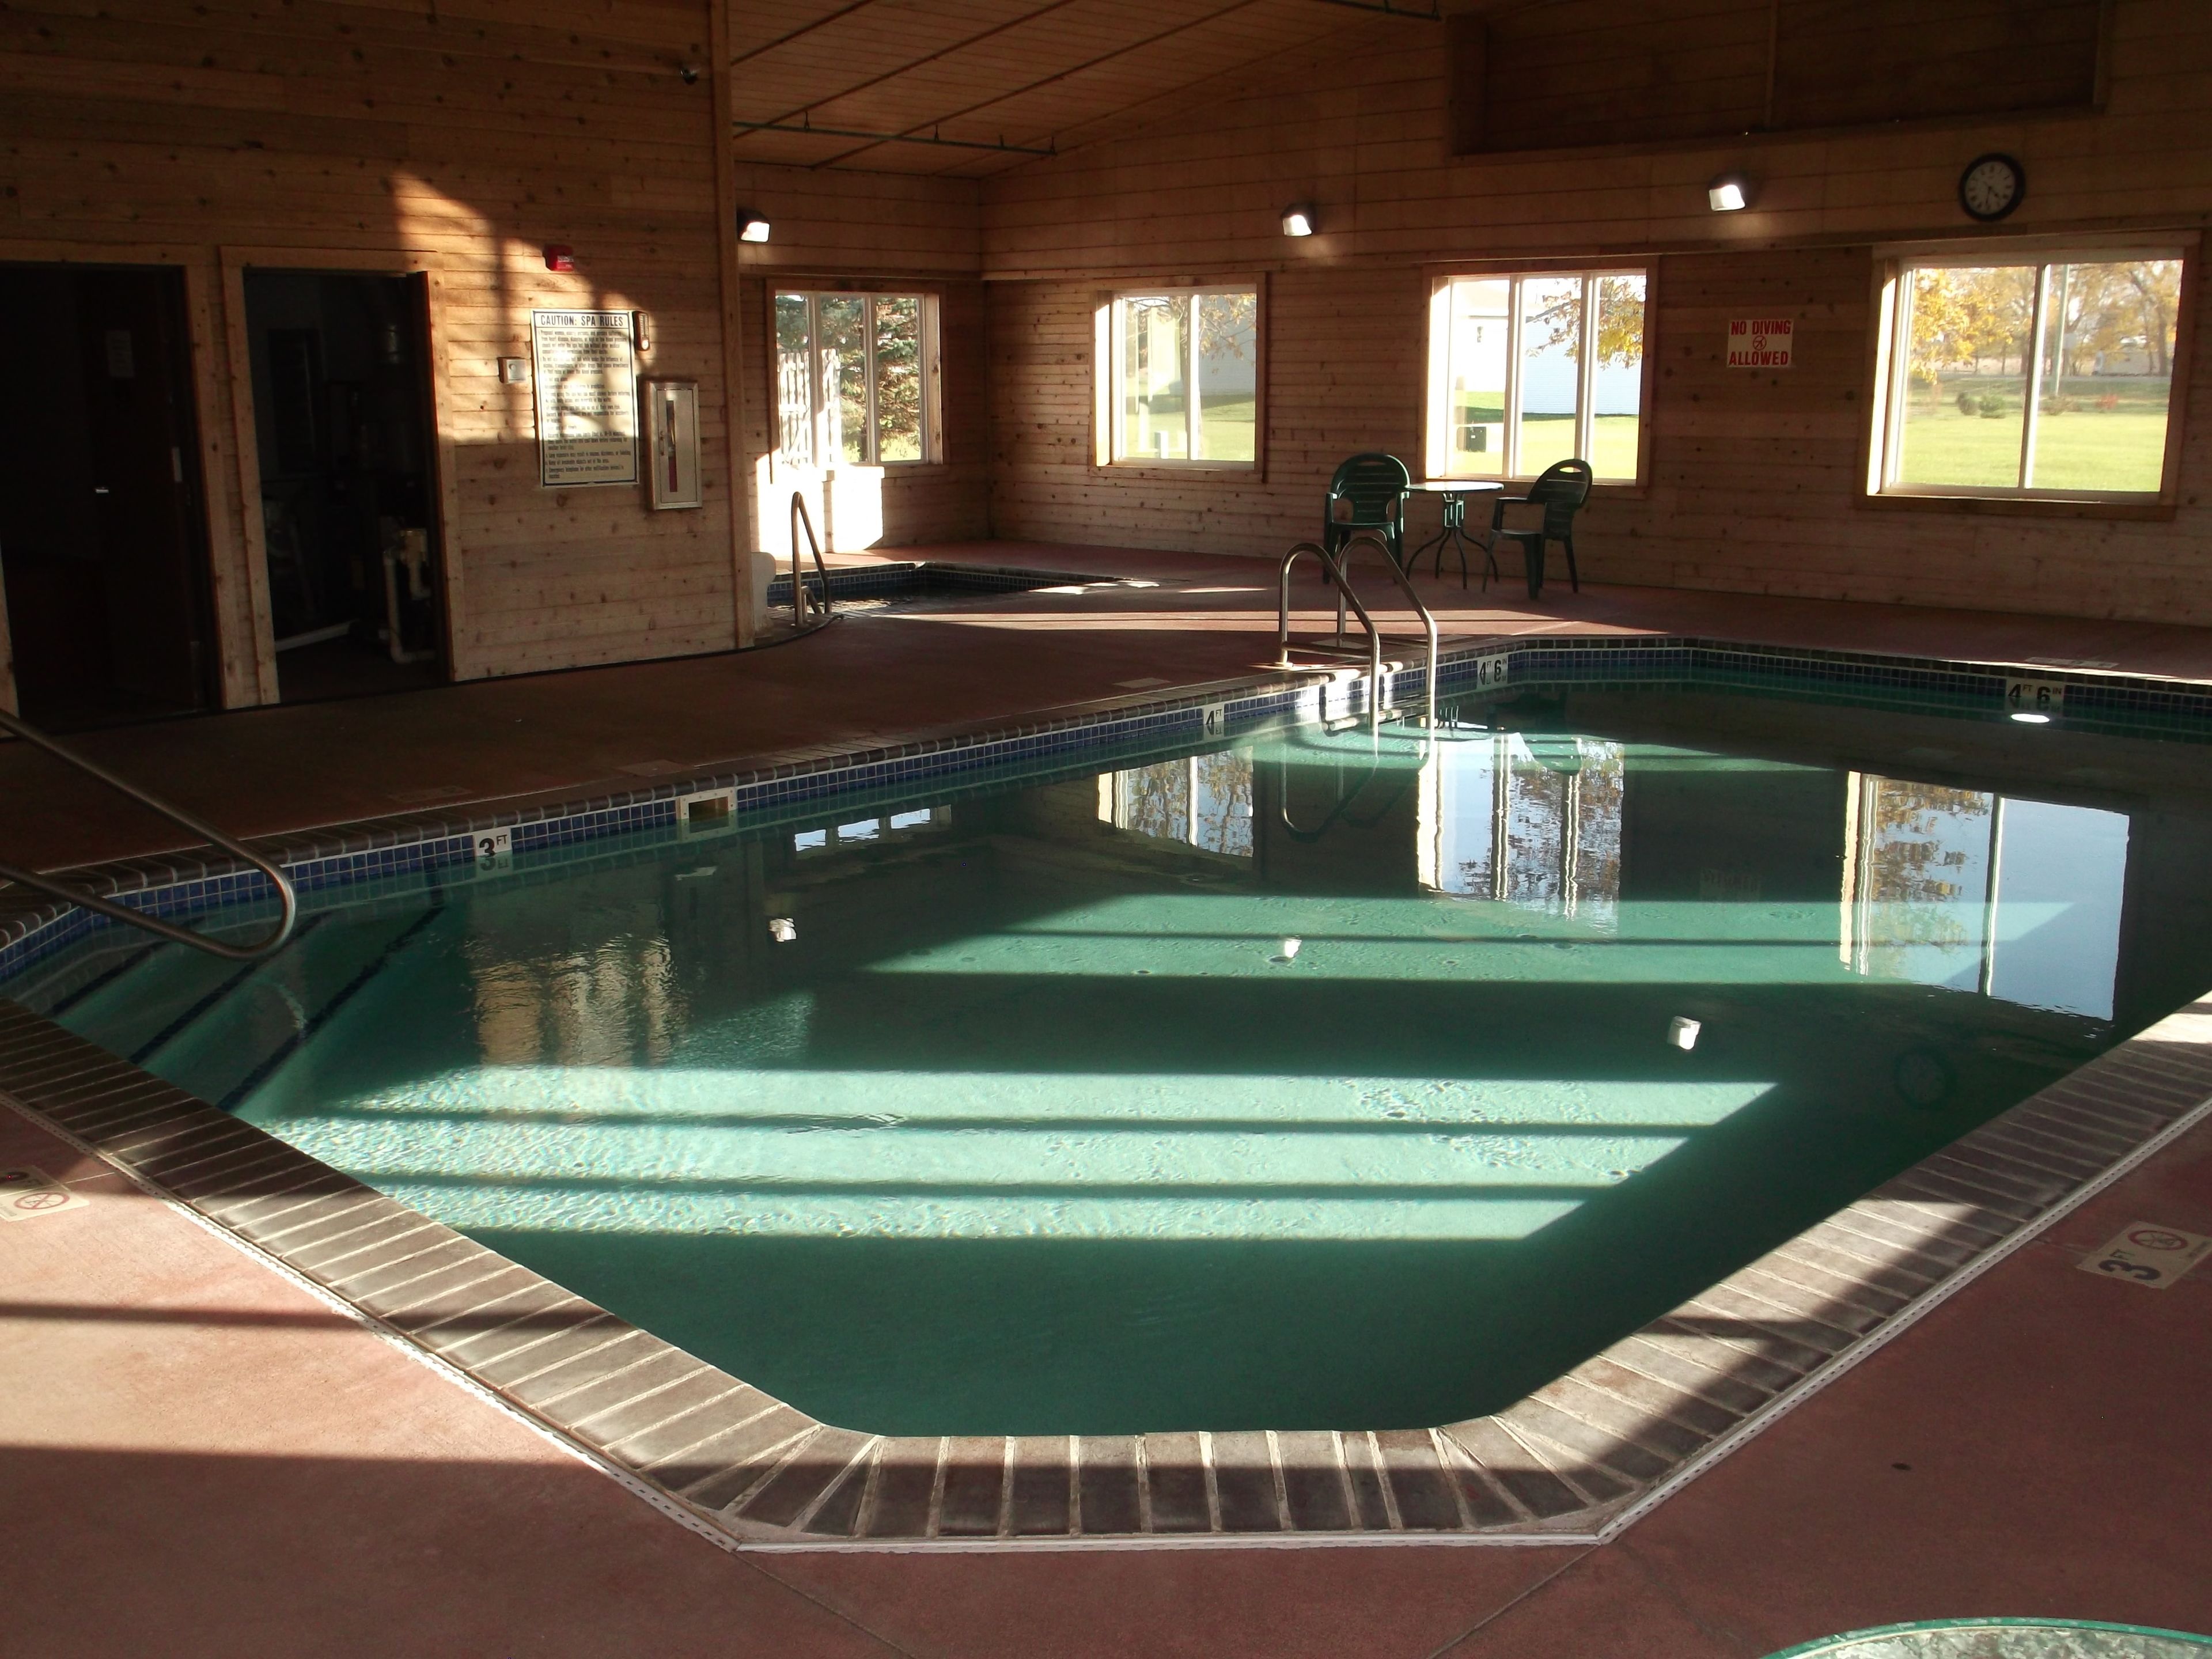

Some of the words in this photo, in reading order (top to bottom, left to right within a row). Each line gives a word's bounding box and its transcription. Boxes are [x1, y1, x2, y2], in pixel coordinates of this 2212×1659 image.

[541, 315, 577, 326] CAUTION:
[581, 316, 596, 326] SPA
[600, 316, 623, 327] RULES
[1731, 321, 1747, 335] NO
[1752, 320, 1791, 335] DIVING
[1729, 351, 1789, 366] ALLOWED
[1479, 662, 1486, 675] 4
[1494, 660, 1502, 675] 6
[2008, 684, 2021, 697] 4
[2037, 686, 2051, 700] 6
[1206, 710, 1214, 725] 4
[1215, 709, 1222, 718] FT
[479, 838, 495, 857] 3
[497, 834, 507, 846] FT
[2098, 1259, 2161, 1281] 3
